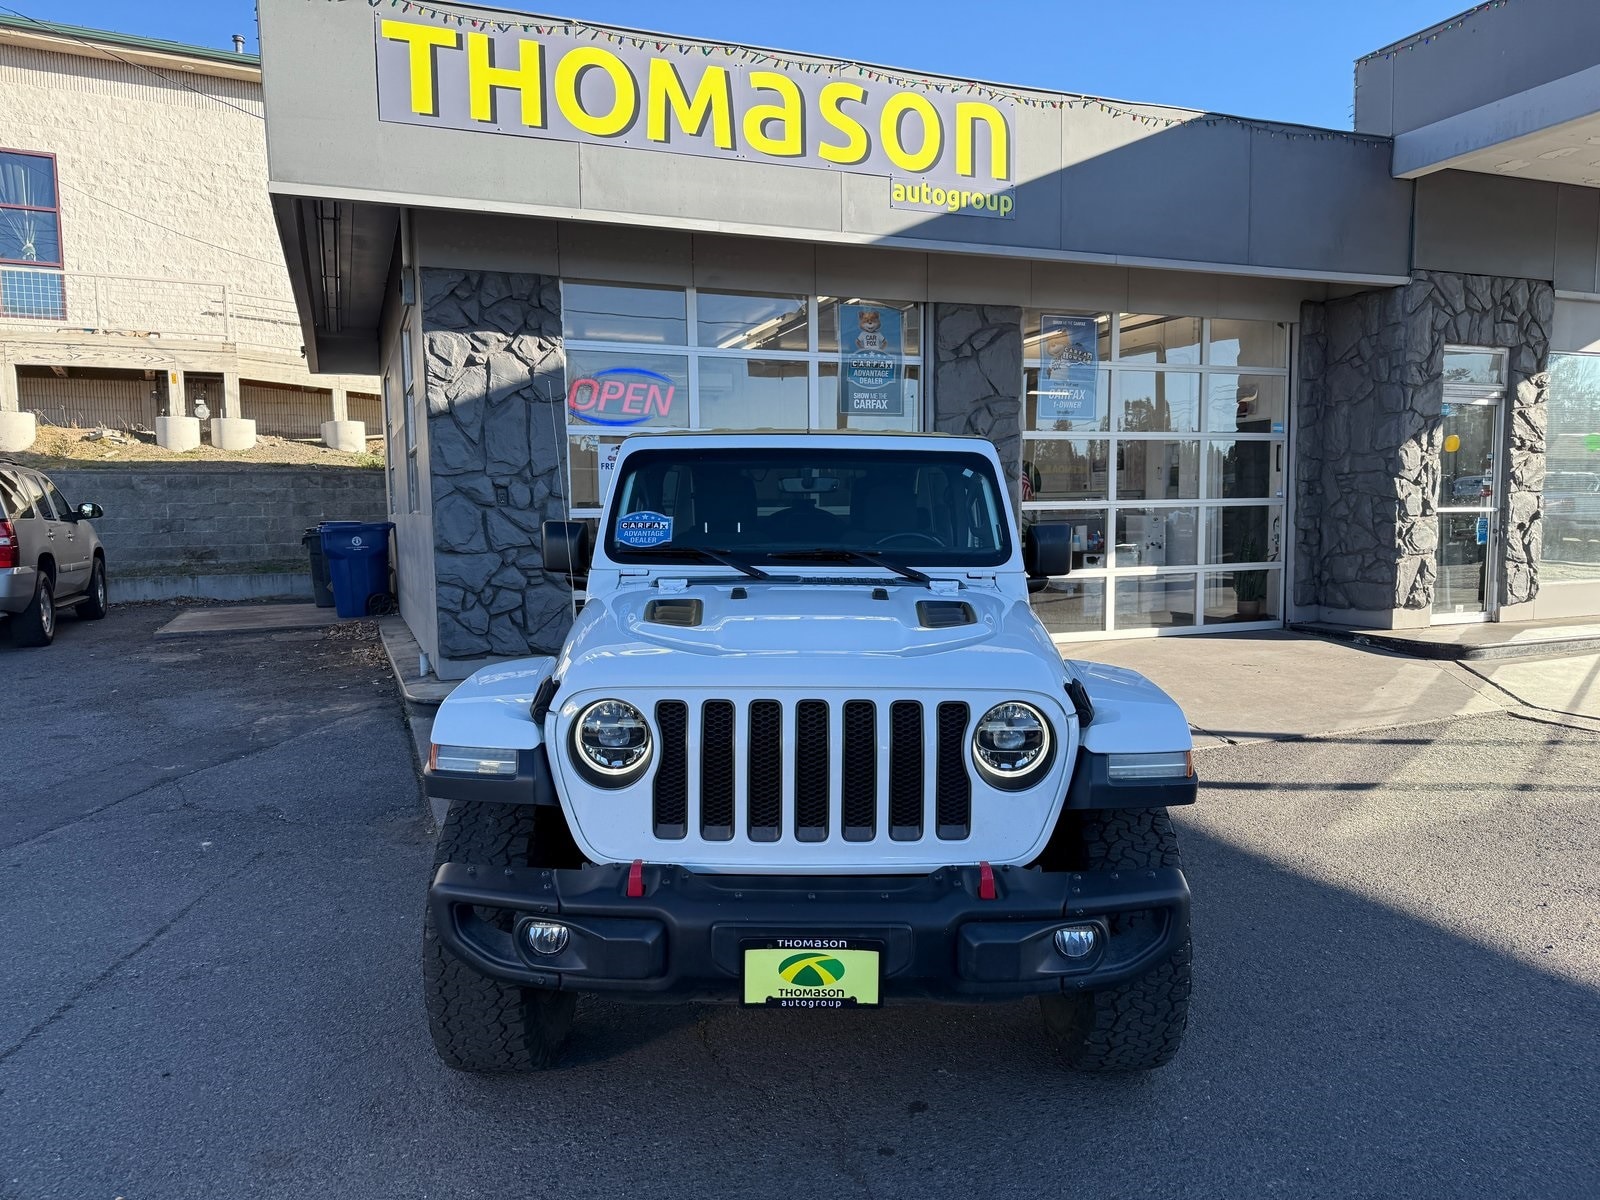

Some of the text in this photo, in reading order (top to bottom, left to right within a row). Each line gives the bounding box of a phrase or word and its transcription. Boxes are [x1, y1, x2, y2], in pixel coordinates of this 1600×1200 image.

[892, 182, 1014, 216] autogroup
[568, 378, 676, 417] OPEN
[1048, 388, 1086, 400] CARFAX
[853, 400, 888, 409] CARFAX
[781, 1000, 842, 1008] autogroup
